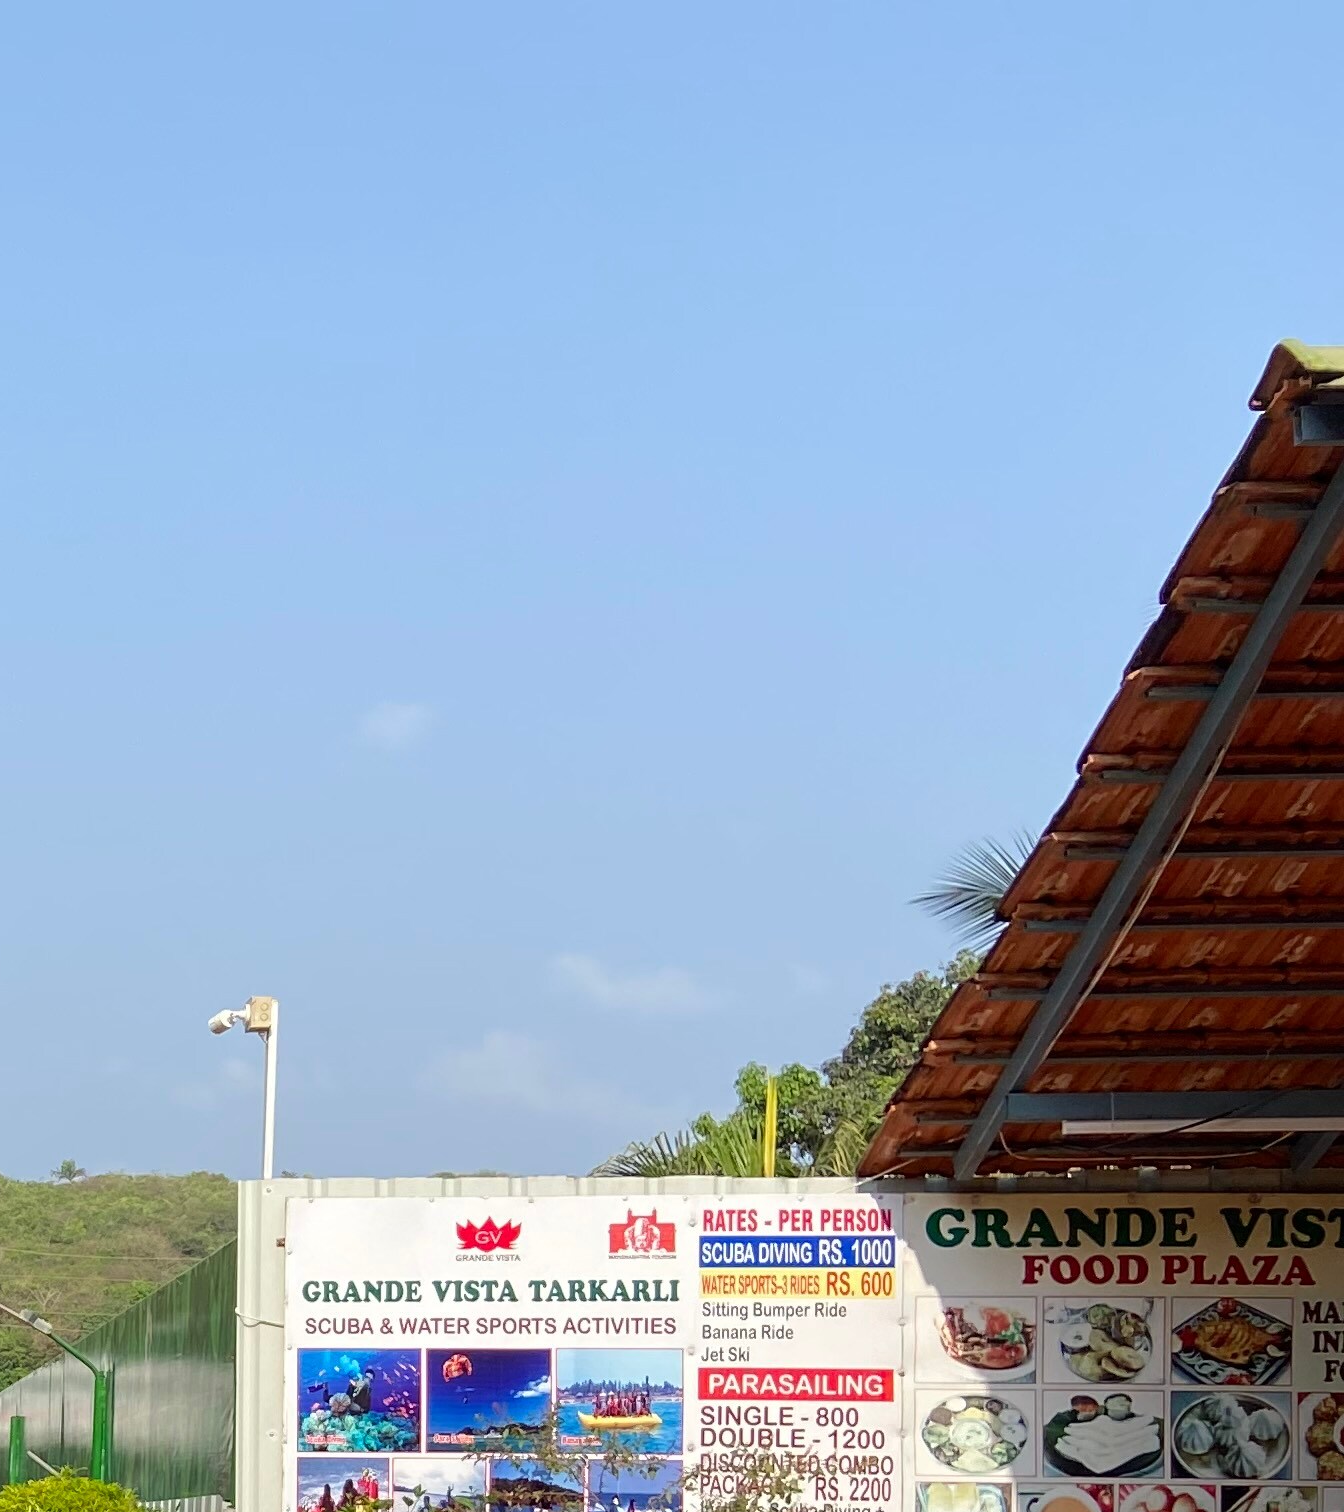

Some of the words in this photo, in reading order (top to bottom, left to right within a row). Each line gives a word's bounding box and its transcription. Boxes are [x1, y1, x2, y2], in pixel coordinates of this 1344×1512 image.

[703, 1208, 758, 1232] RATES
[778, 1208, 813, 1232] PER
[820, 1208, 893, 1232] PERSON
[925, 1206, 1198, 1248] GRANDE
[475, 1229, 502, 1245] GV
[455, 1254, 494, 1262] GRANDE
[496, 1254, 521, 1262] VISTA
[701, 1242, 755, 1264] SCUBA
[758, 1242, 813, 1264] DIVING
[818, 1238, 846, 1265] RS.
[852, 1238, 893, 1265] 1000
[1022, 1254, 1149, 1286] FOOD
[1161, 1254, 1317, 1286] PLAZA
[301, 1280, 422, 1303] GRANDE
[432, 1279, 520, 1303] VISTA
[528, 1279, 680, 1302] TARKARLI
[701, 1275, 736, 1295] WATER
[790, 1275, 820, 1295] RIDES
[826, 1271, 855, 1297] RS.
[861, 1271, 893, 1297] 600
[702, 1301, 749, 1320] Sitting
[753, 1302, 810, 1320] Bumper
[814, 1302, 847, 1317] Ride
[1302, 1301, 1344, 1324] MA
[305, 1318, 374, 1335] SCUBA
[380, 1318, 394, 1335] &
[398, 1318, 470, 1335] WATER
[475, 1318, 558, 1335] SPORTS
[562, 1318, 677, 1335] ACTIVITIES
[702, 1324, 757, 1340] Banana
[761, 1324, 794, 1340] Ride
[1313, 1330, 1344, 1353] IN
[701, 1346, 725, 1362] Jet
[728, 1346, 750, 1362] Ski
[708, 1373, 884, 1397] PARASAILING
[700, 1406, 794, 1427] SINGLE
[816, 1407, 859, 1427] 800
[700, 1428, 806, 1449] DOUBLE
[828, 1429, 886, 1450] 1200
[825, 1455, 894, 1476] COMBO
[700, 1475, 784, 1496] PACKAG
[815, 1477, 843, 1501] RS.
[849, 1477, 892, 1501] 2200
